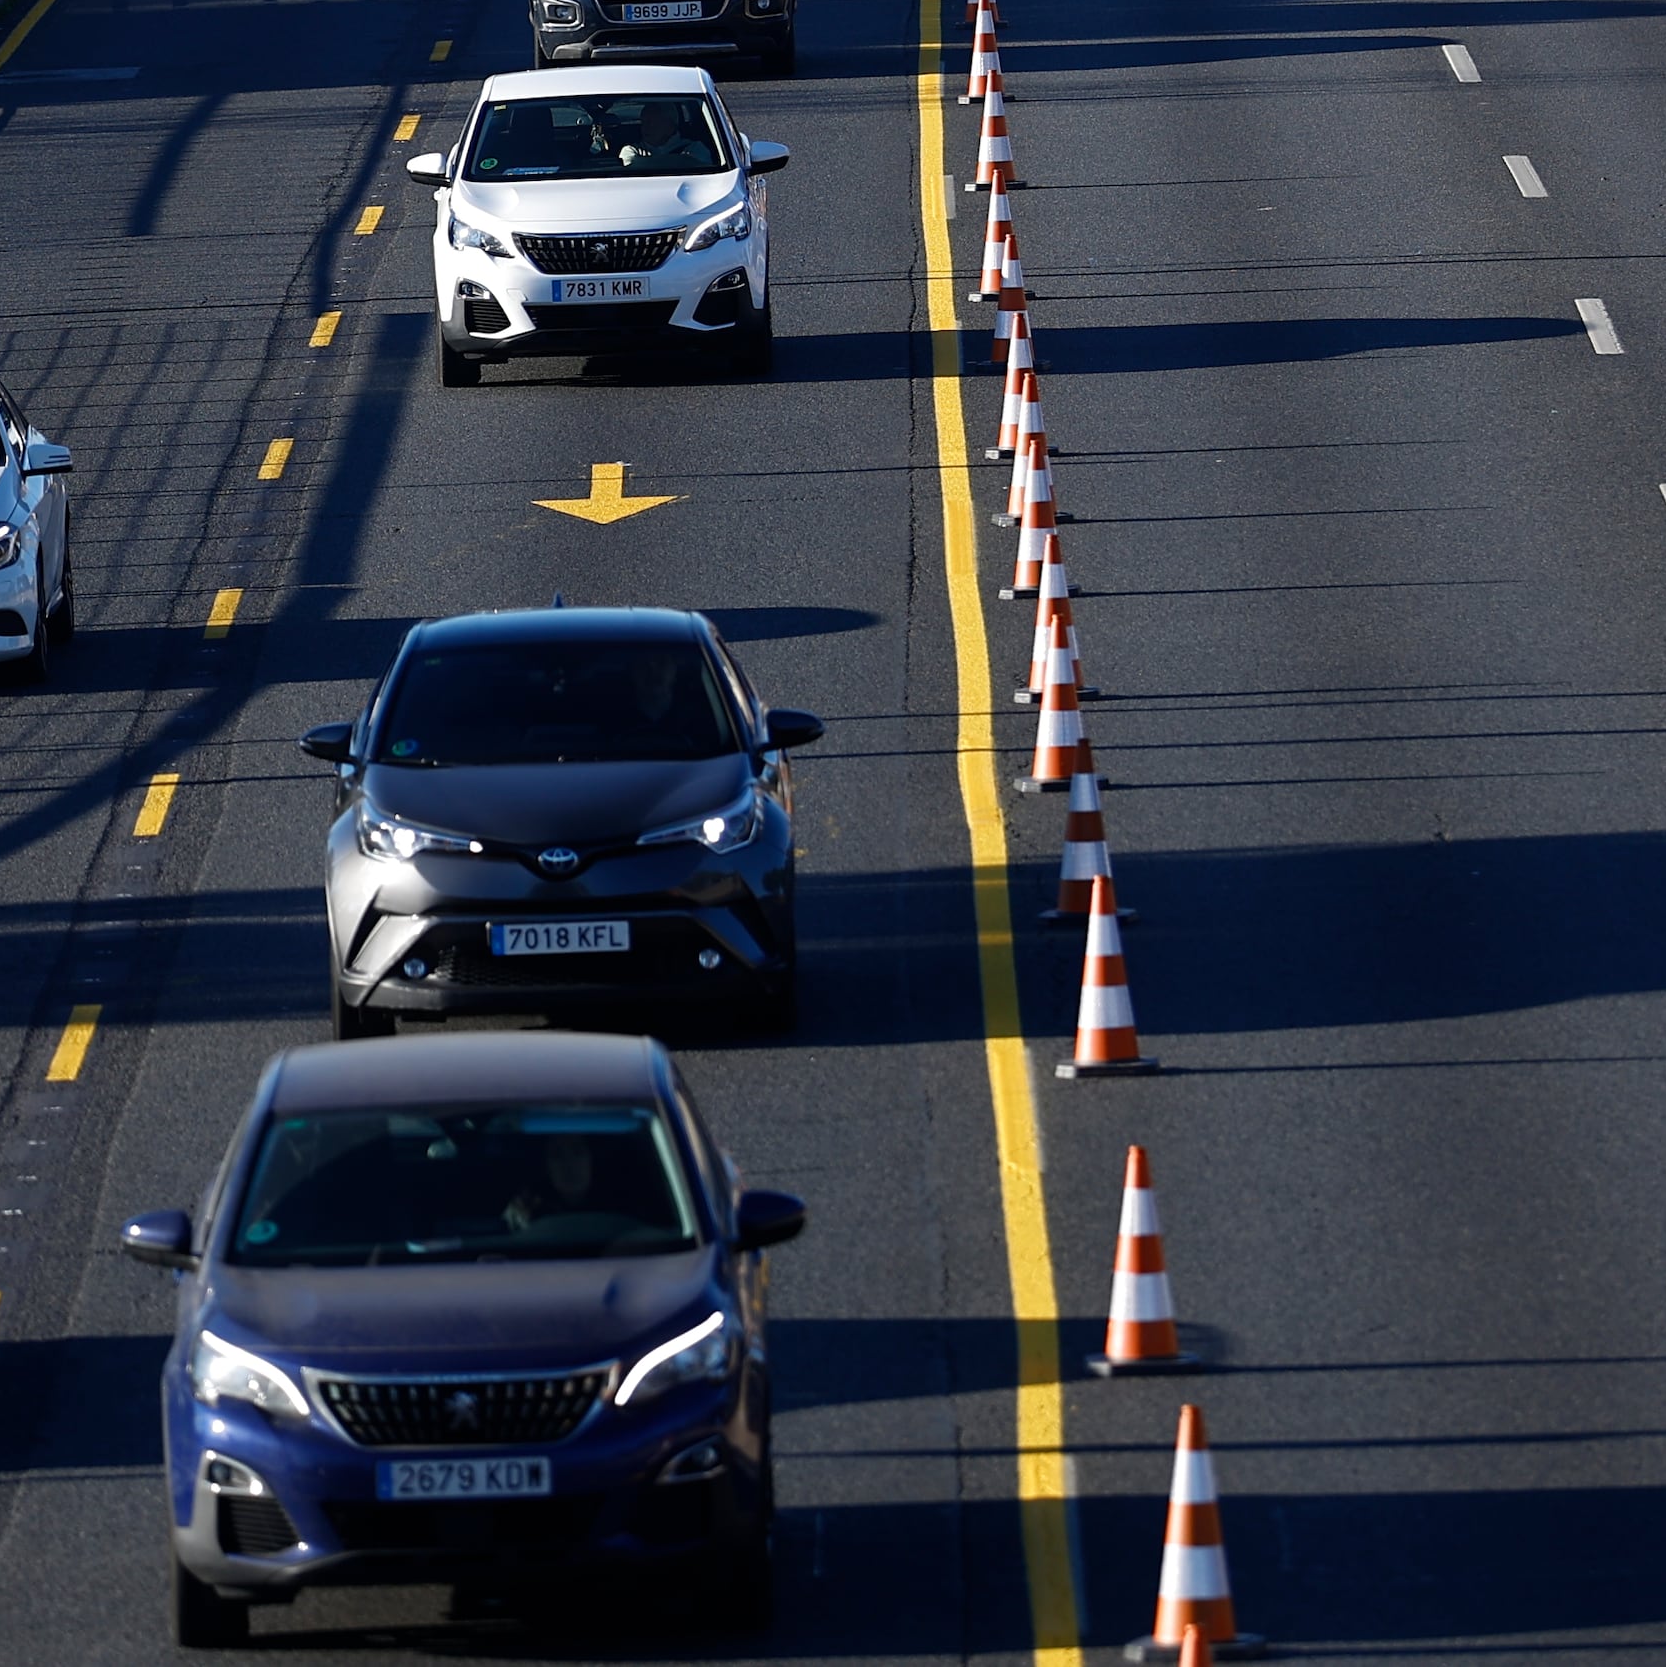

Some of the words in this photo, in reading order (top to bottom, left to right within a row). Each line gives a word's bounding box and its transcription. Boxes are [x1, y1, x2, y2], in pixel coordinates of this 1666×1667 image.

[634, 4, 668, 19] 9699
[673, 3, 698, 18] JJP
[566, 281, 605, 298] 7831
[612, 280, 642, 297] KMR
[509, 926, 570, 950] 7018
[578, 924, 623, 948] KFL
[398, 1463, 476, 1493] 2679
